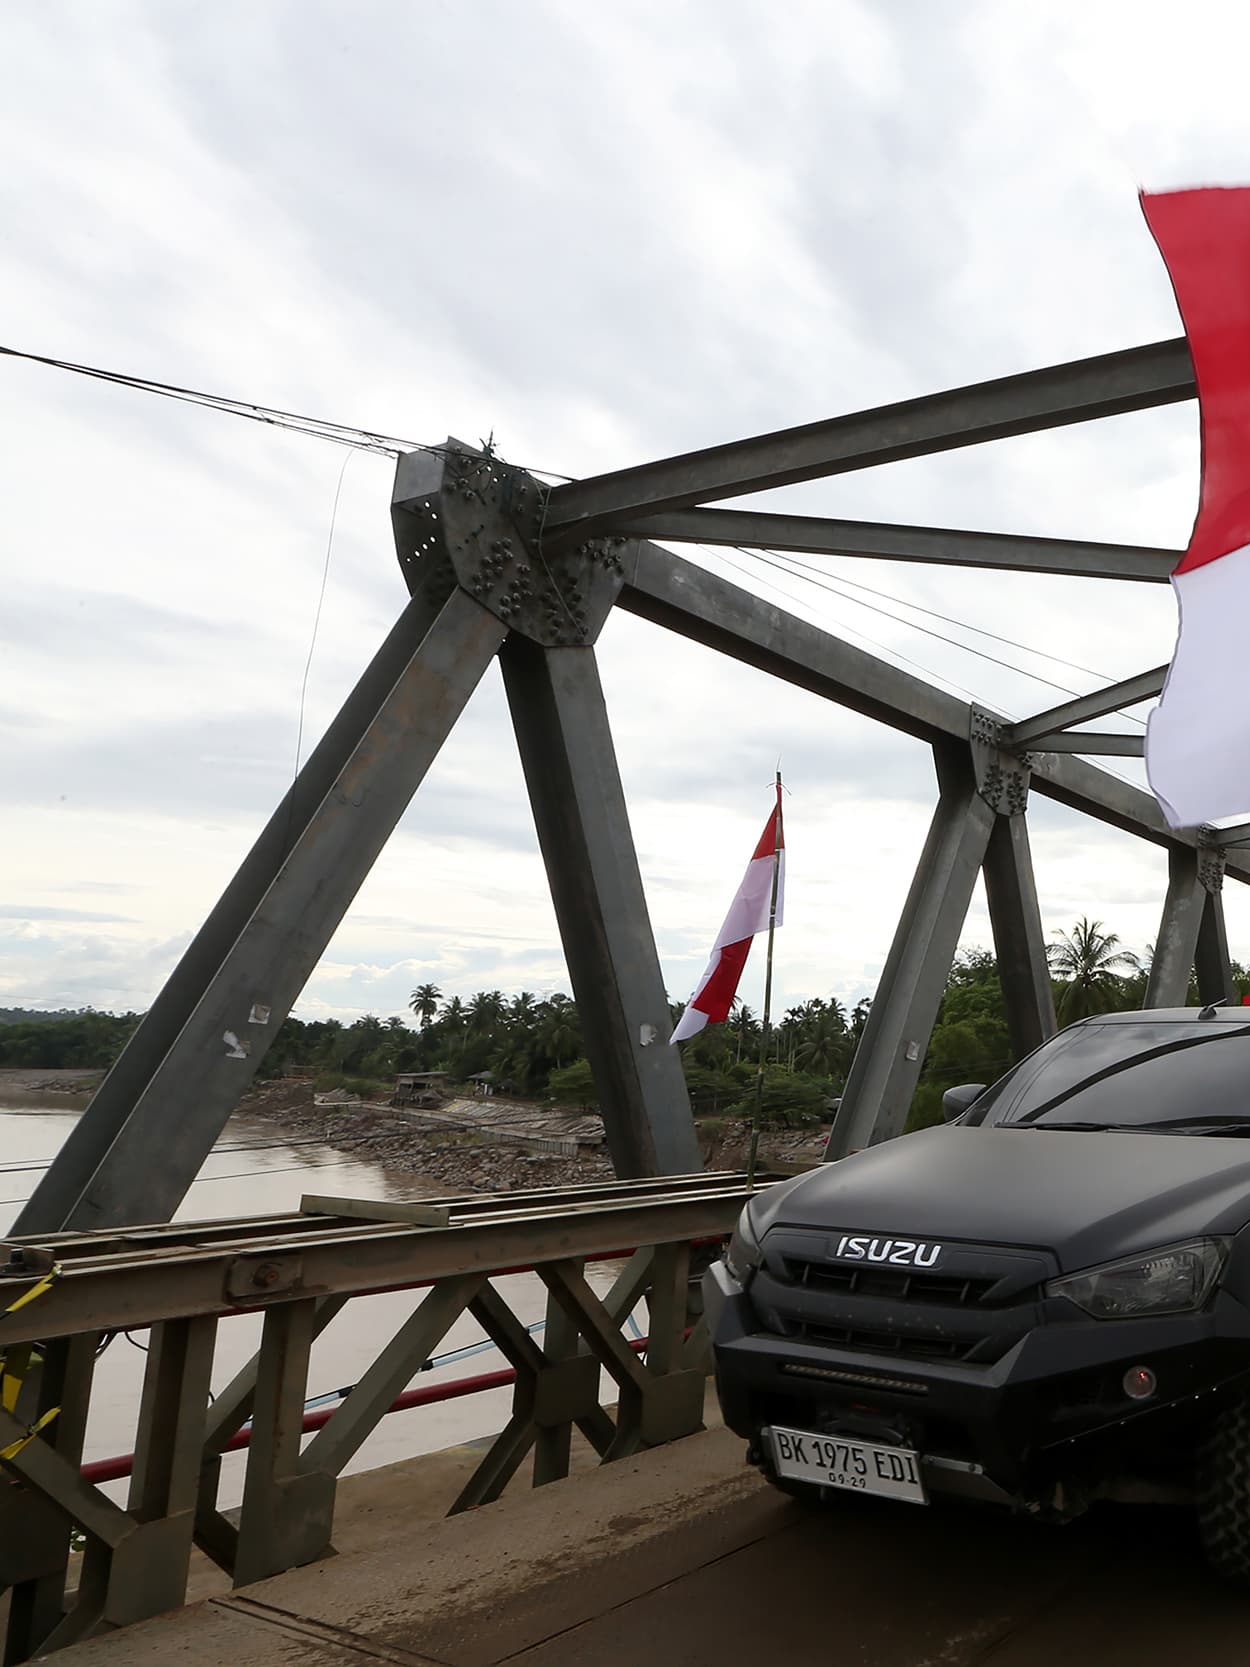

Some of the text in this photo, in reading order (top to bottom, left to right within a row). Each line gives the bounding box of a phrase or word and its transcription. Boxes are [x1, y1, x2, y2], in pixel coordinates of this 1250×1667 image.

[836, 1236, 941, 1267] ISUZU
[777, 1433, 918, 1484] BK 1975 EDI
